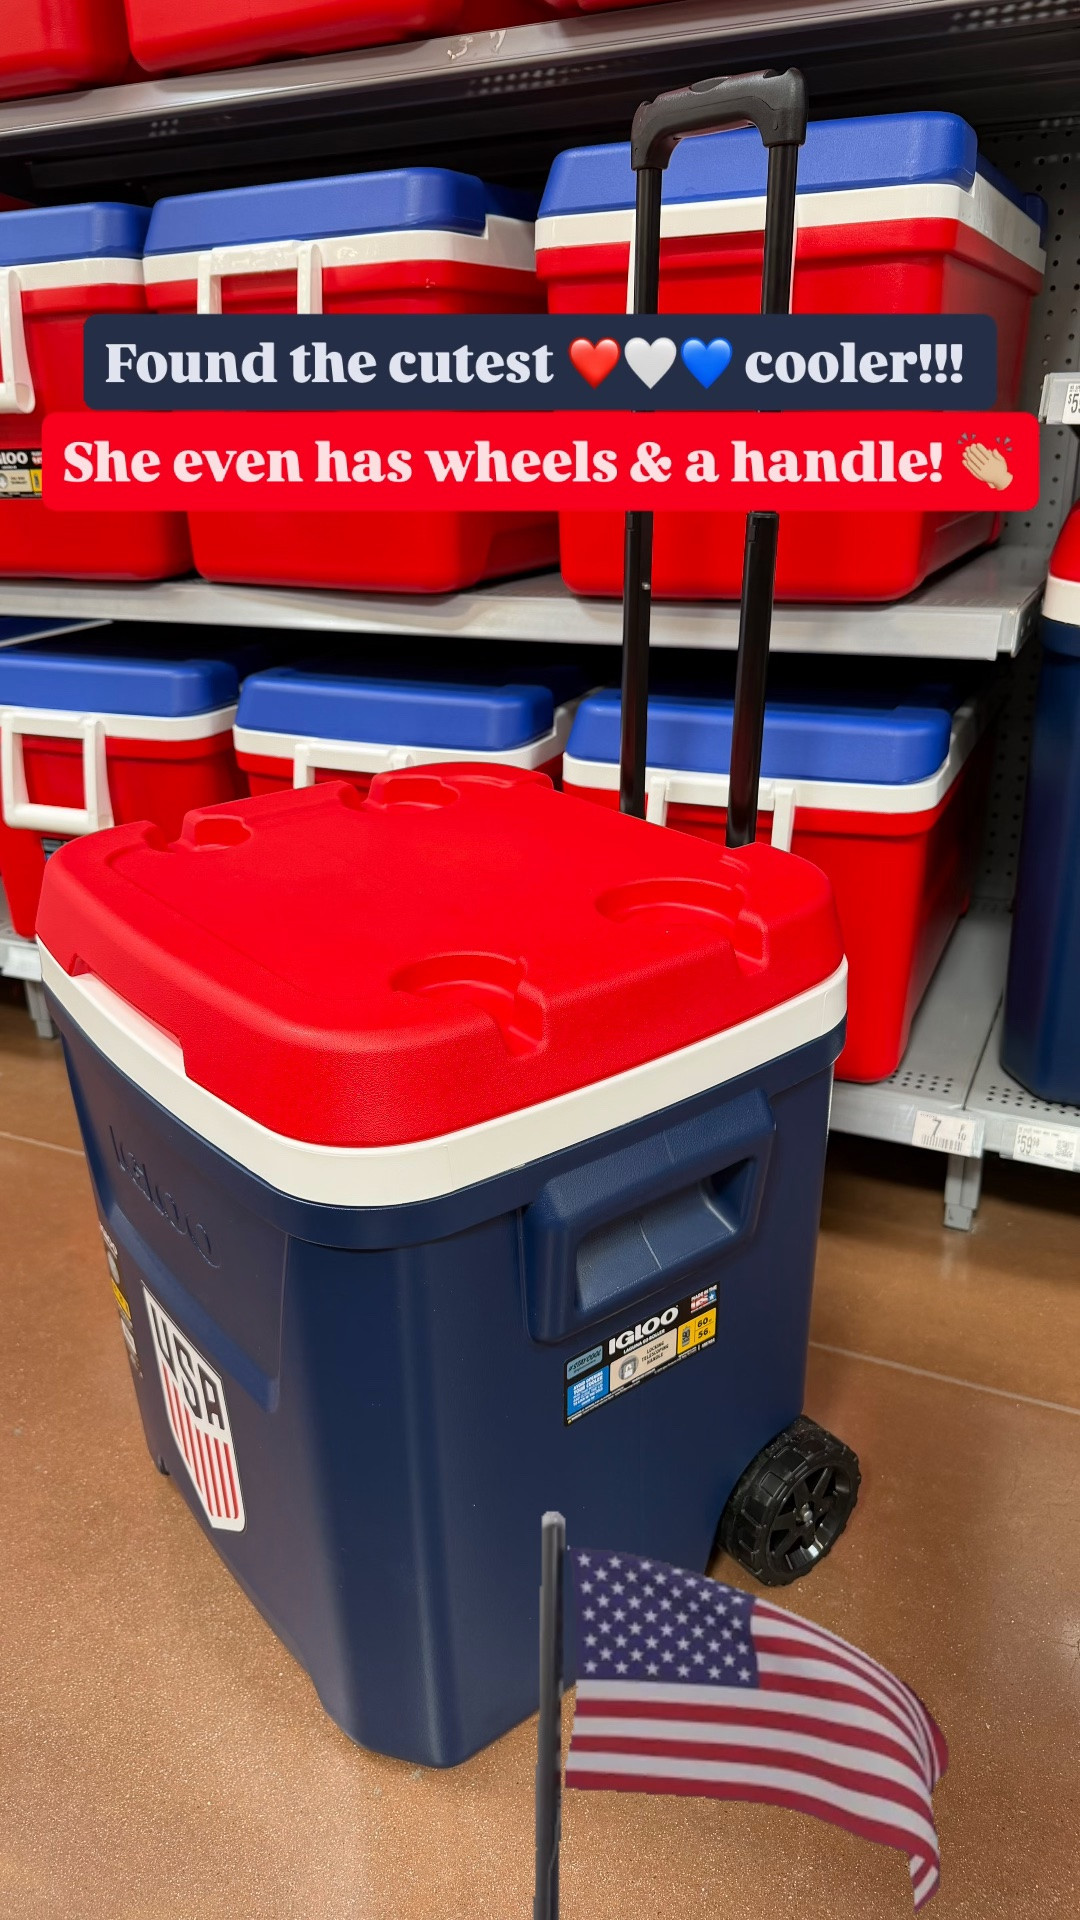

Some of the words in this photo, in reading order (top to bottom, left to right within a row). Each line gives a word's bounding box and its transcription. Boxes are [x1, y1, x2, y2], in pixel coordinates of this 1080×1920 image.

[698, 1317, 708, 1328] 60
[609, 1307, 679, 1355] IGLOO
[698, 1327, 708, 1339] 56
[647, 1340, 664, 1354] LOCKING
[150, 1302, 226, 1431] USA
